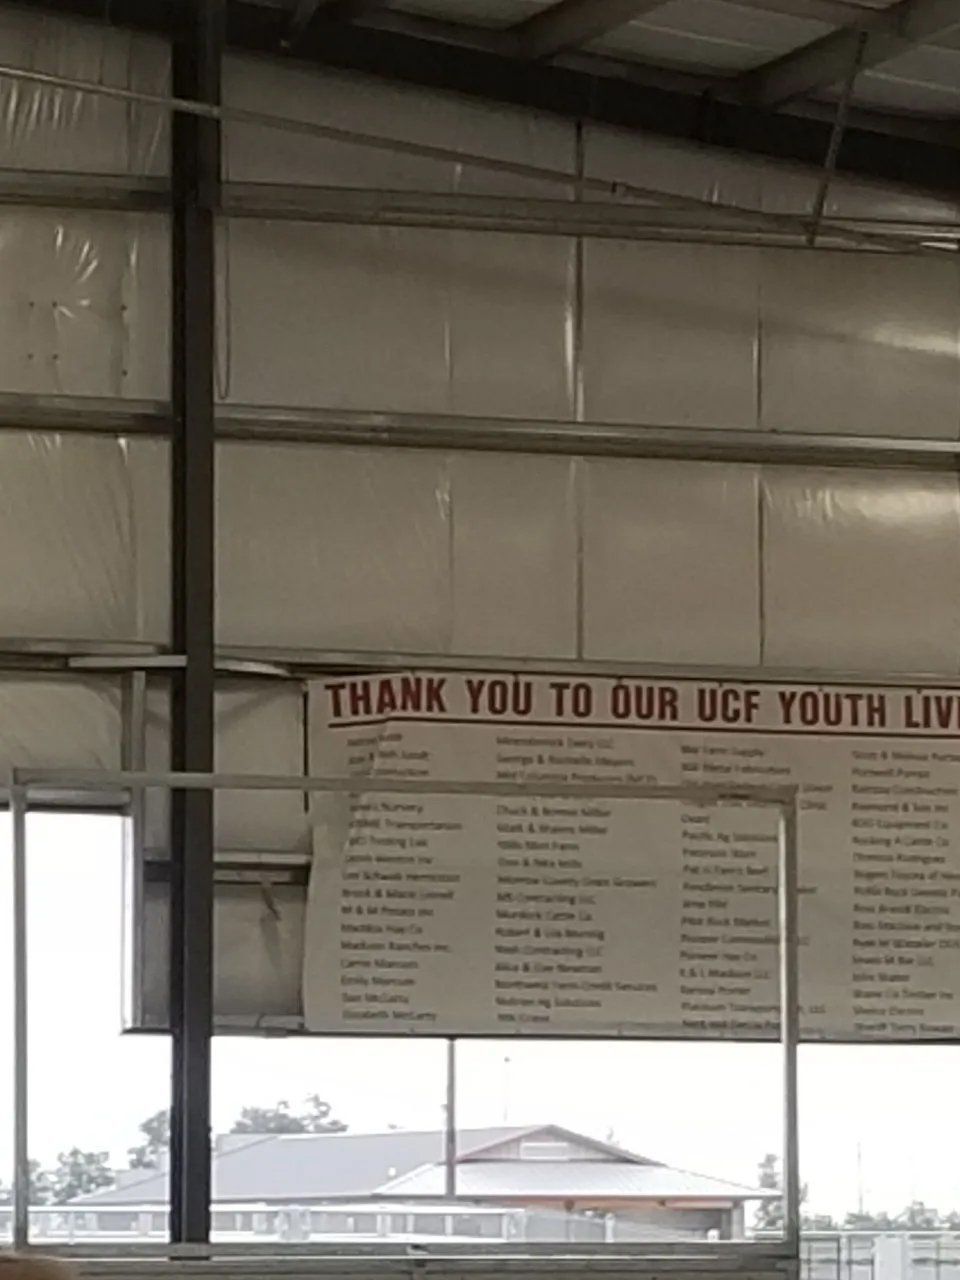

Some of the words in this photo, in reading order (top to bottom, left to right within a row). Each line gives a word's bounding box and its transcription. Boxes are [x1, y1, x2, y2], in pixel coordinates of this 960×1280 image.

[325, 677, 447, 718] THANK
[466, 680, 532, 716] YOU
[550, 682, 592, 717] TO
[611, 685, 679, 720] OUR
[698, 688, 760, 723] UCF
[779, 691, 886, 727] YOUTH
